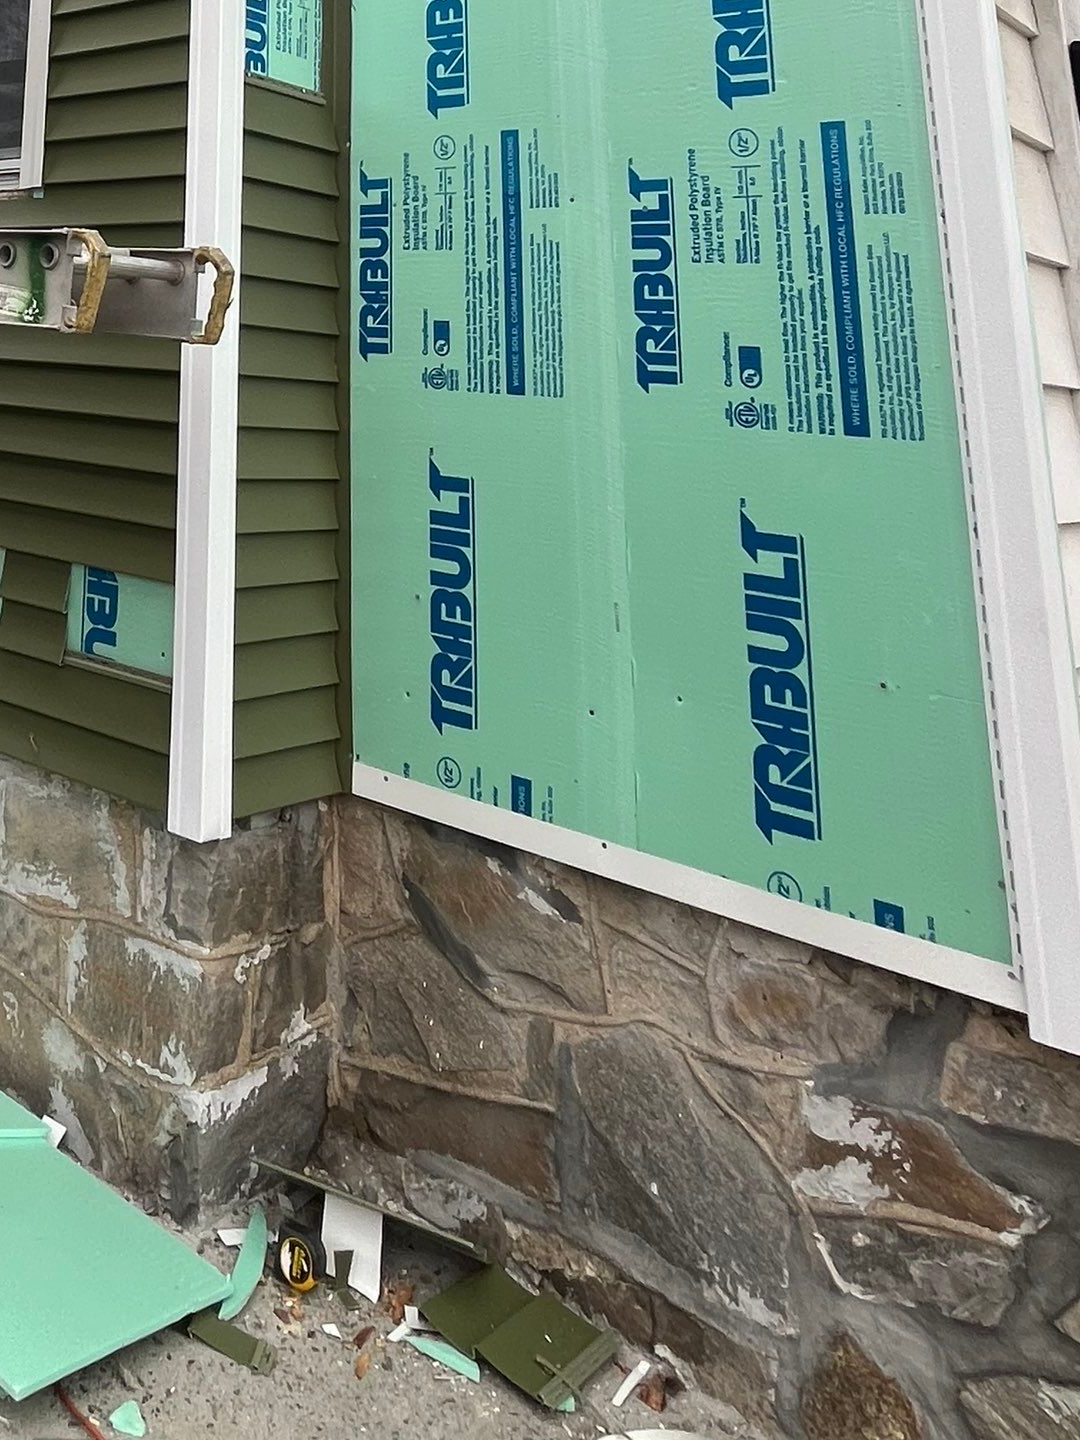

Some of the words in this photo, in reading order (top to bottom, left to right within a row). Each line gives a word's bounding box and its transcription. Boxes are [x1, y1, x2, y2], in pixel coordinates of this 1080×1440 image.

[402, 152, 411, 205] Polystyrene
[685, 148, 700, 210] Polystyrene
[829, 128, 842, 199] REGULATIONS
[411, 175, 419, 202] Board
[699, 175, 711, 206] Board
[402, 208, 410, 250] Extruded
[411, 204, 420, 250] Insulation
[834, 201, 844, 222] HFC
[689, 213, 701, 263] Extruded
[701, 209, 715, 263] Insulation
[836, 224, 847, 257] LOCAL
[839, 259, 849, 286] WITH
[841, 288, 854, 350] COMPLIANT
[849, 386, 860, 425] WHERE
